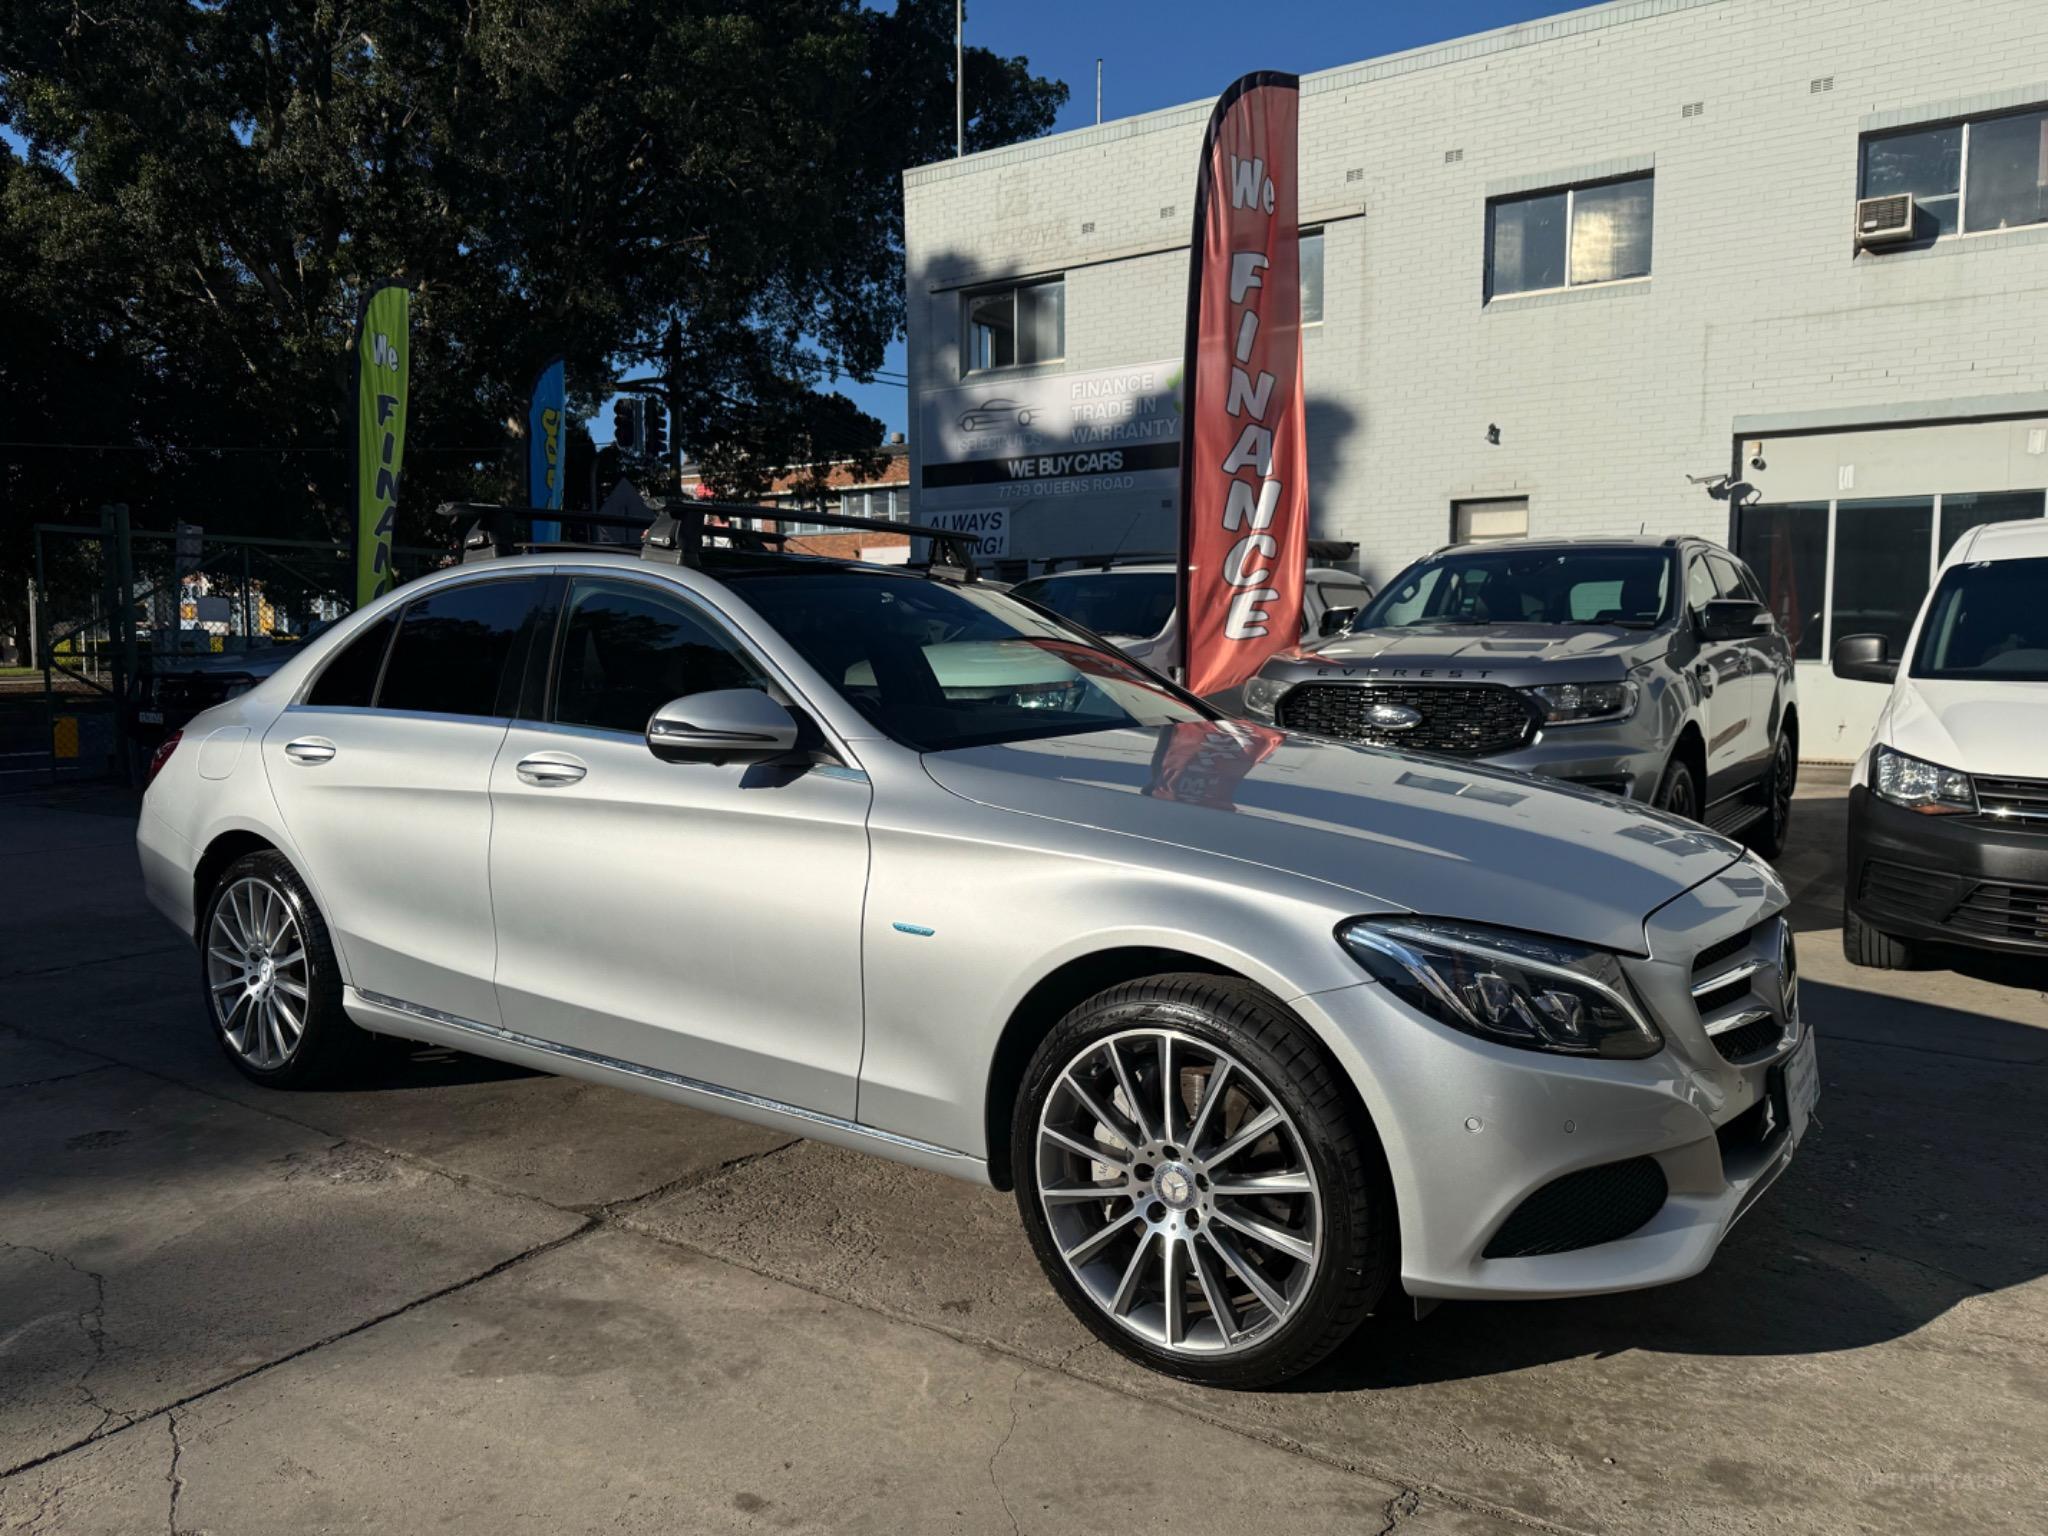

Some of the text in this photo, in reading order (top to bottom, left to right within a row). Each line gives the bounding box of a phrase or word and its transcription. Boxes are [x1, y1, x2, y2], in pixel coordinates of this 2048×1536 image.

[1231, 155, 1275, 216] We
[374, 333, 398, 372] We
[1071, 373, 1154, 400] FINANCE
[1071, 396, 1157, 421] TRADE IN
[1071, 417, 1178, 444] WARRANTY
[1222, 252, 1282, 640] FINANCE
[1007, 451, 1124, 479] WE BUY CARS
[1033, 480, 1090, 496] QUEENS
[1093, 476, 1134, 492] ROAD
